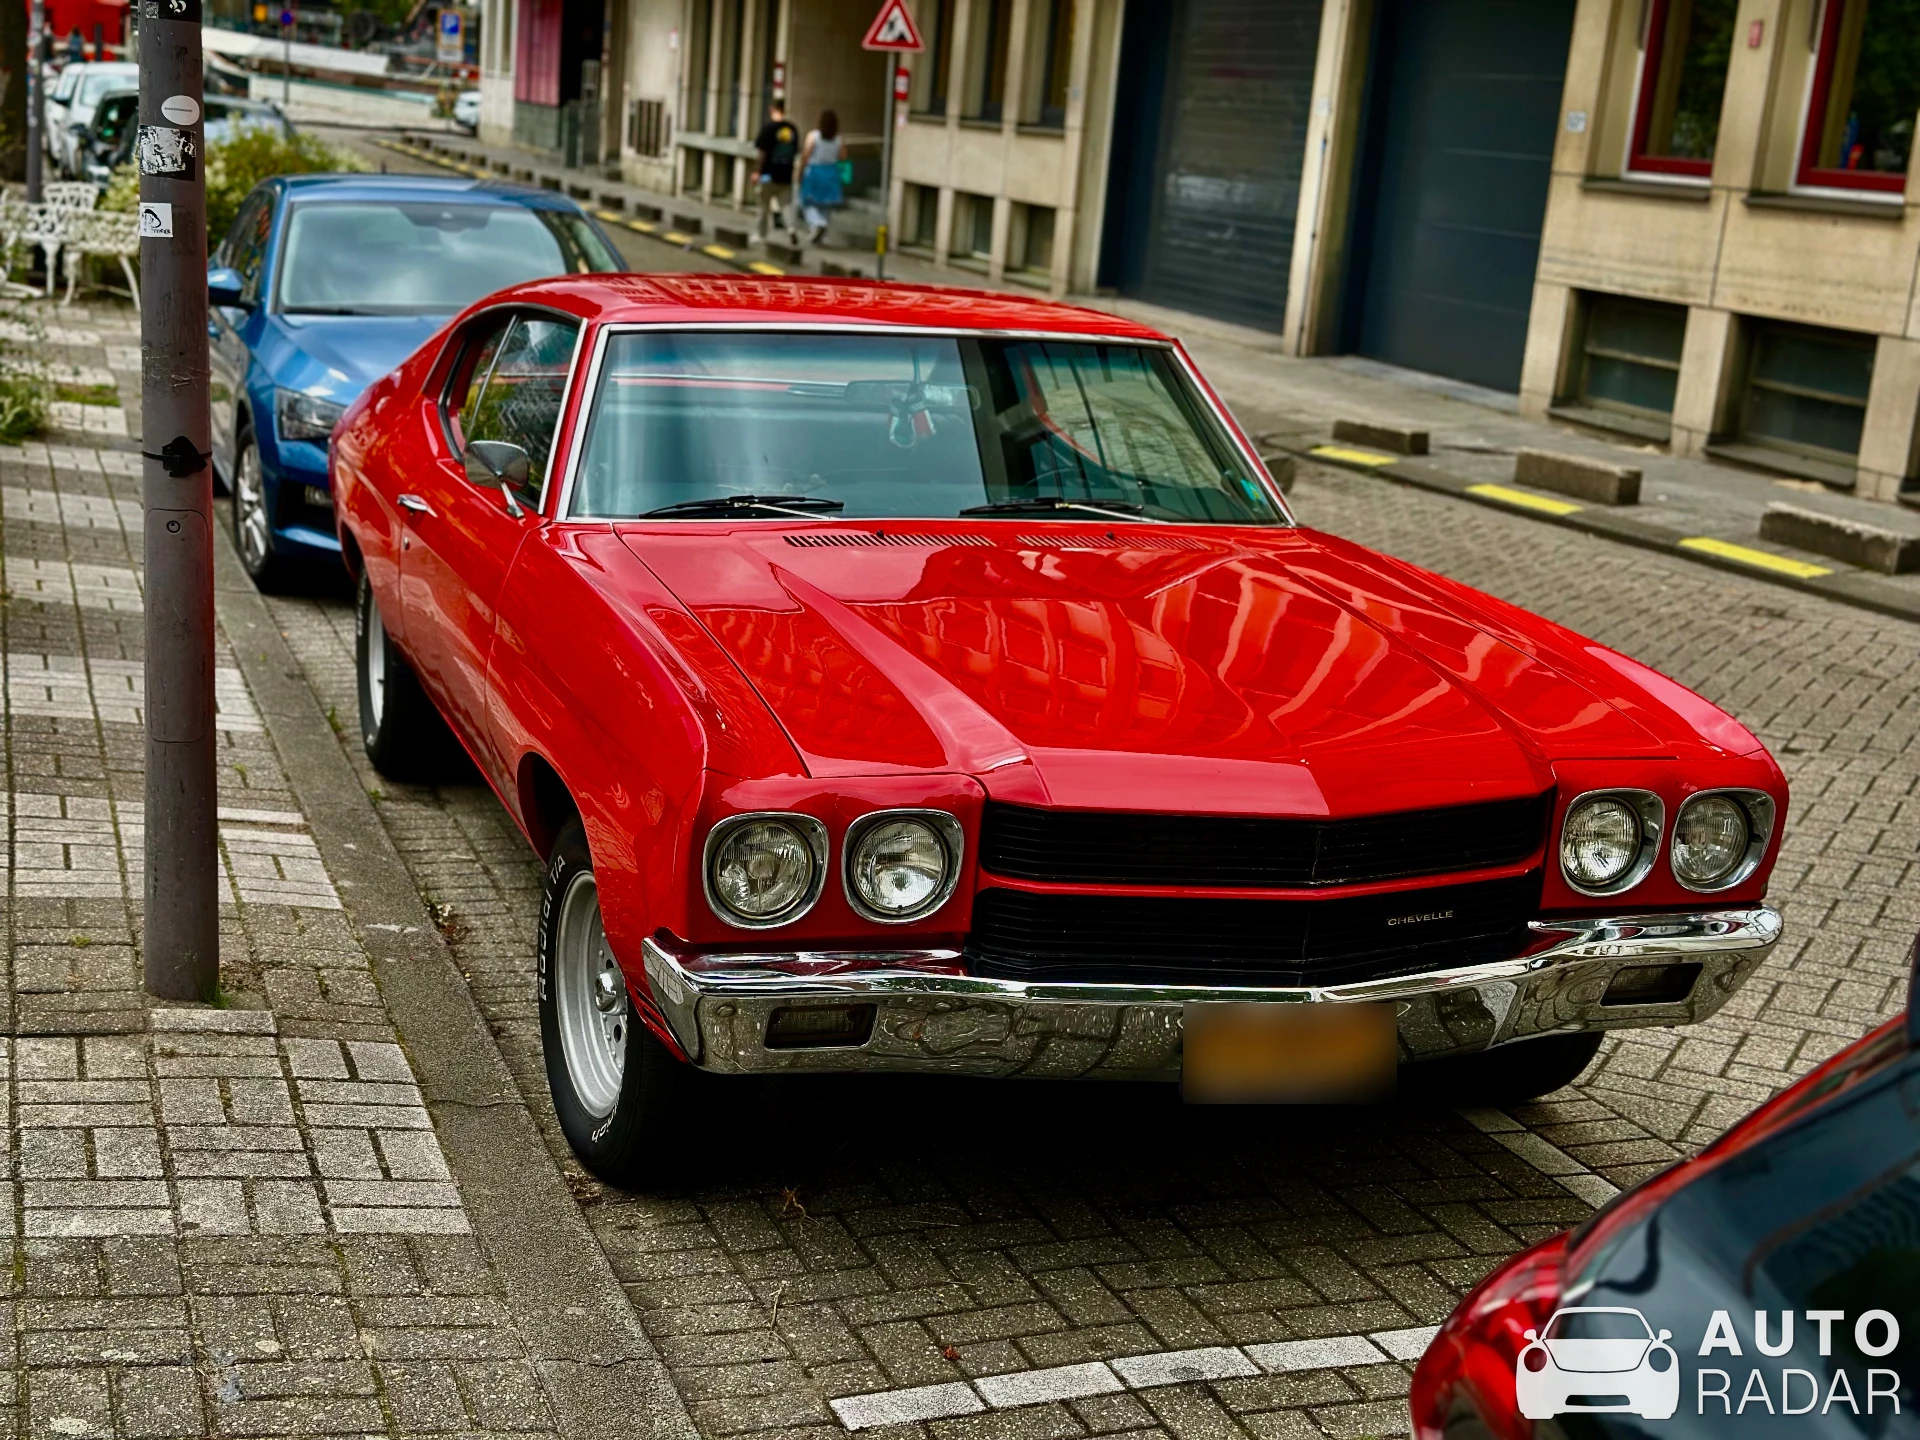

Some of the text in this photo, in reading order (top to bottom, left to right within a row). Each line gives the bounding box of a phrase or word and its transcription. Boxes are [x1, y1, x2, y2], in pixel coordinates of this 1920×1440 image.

[538, 854, 567, 1001] Radial T/A
[1386, 910, 1454, 926] CHEVELLE
